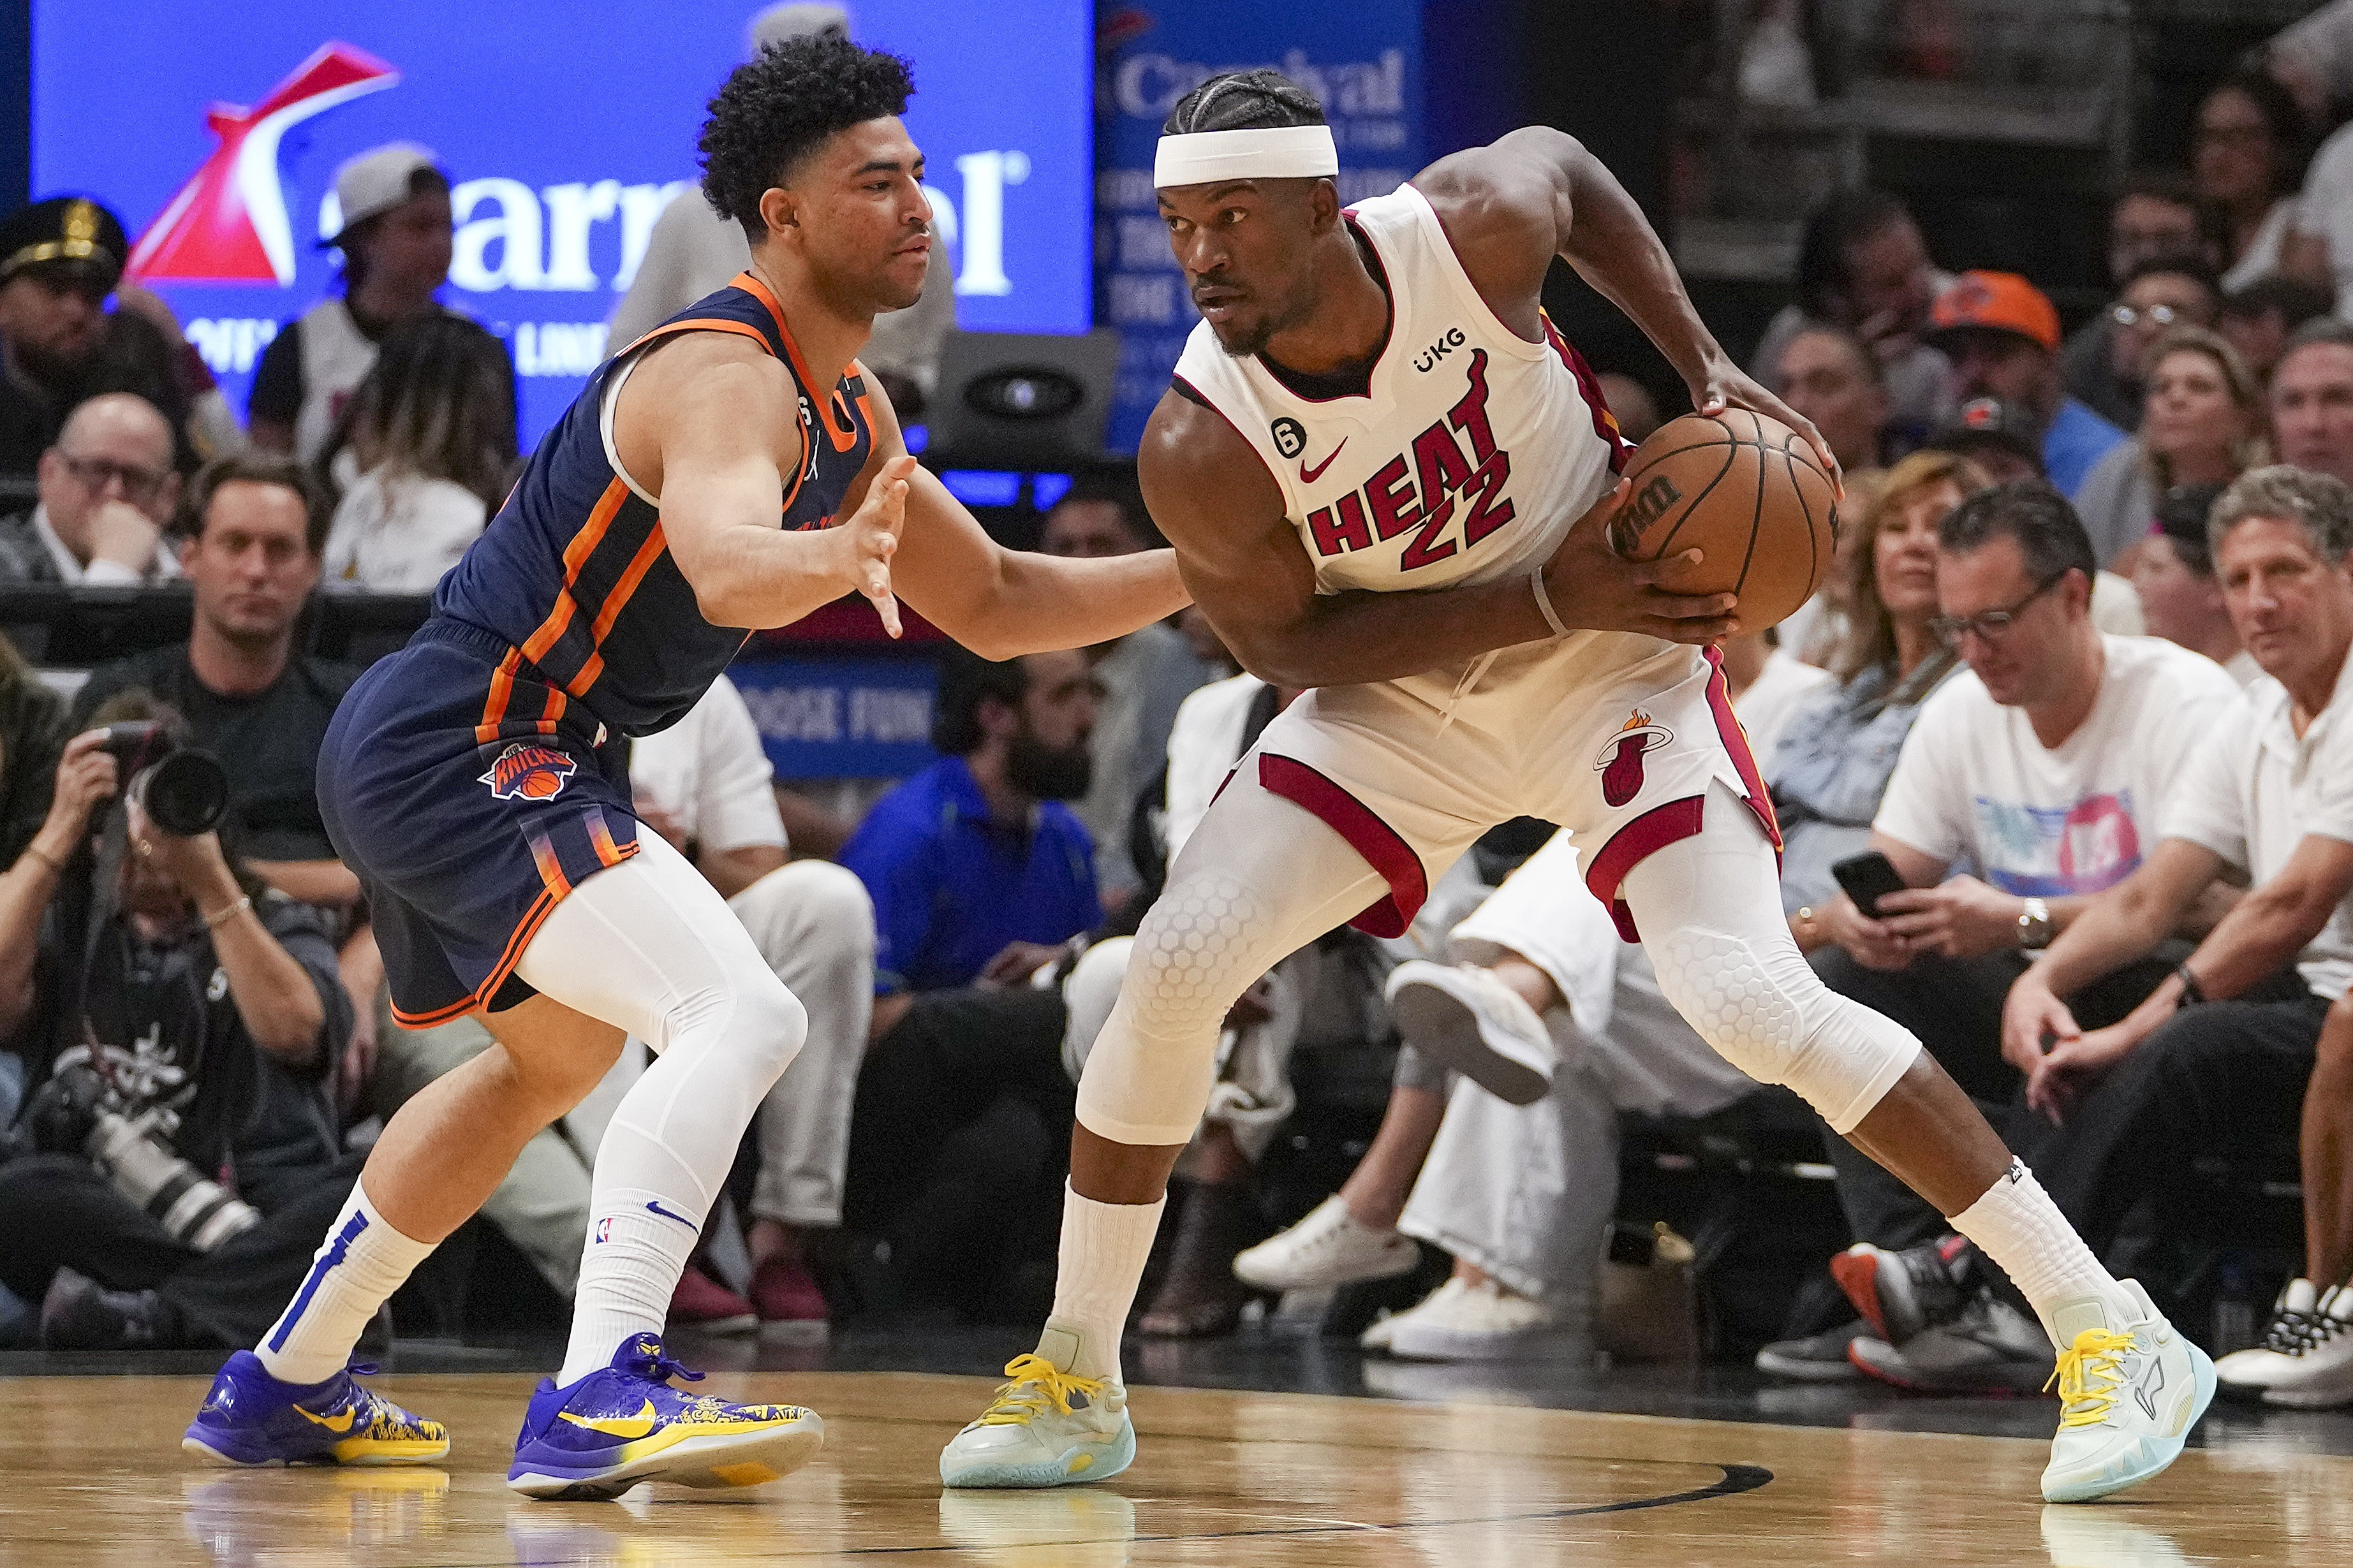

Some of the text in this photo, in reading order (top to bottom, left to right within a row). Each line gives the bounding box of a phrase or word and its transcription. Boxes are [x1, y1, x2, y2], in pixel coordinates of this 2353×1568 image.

[1274, 423, 1299, 455] 6
[1307, 348, 1498, 557] HEAT
[1400, 449, 1516, 573] 22
